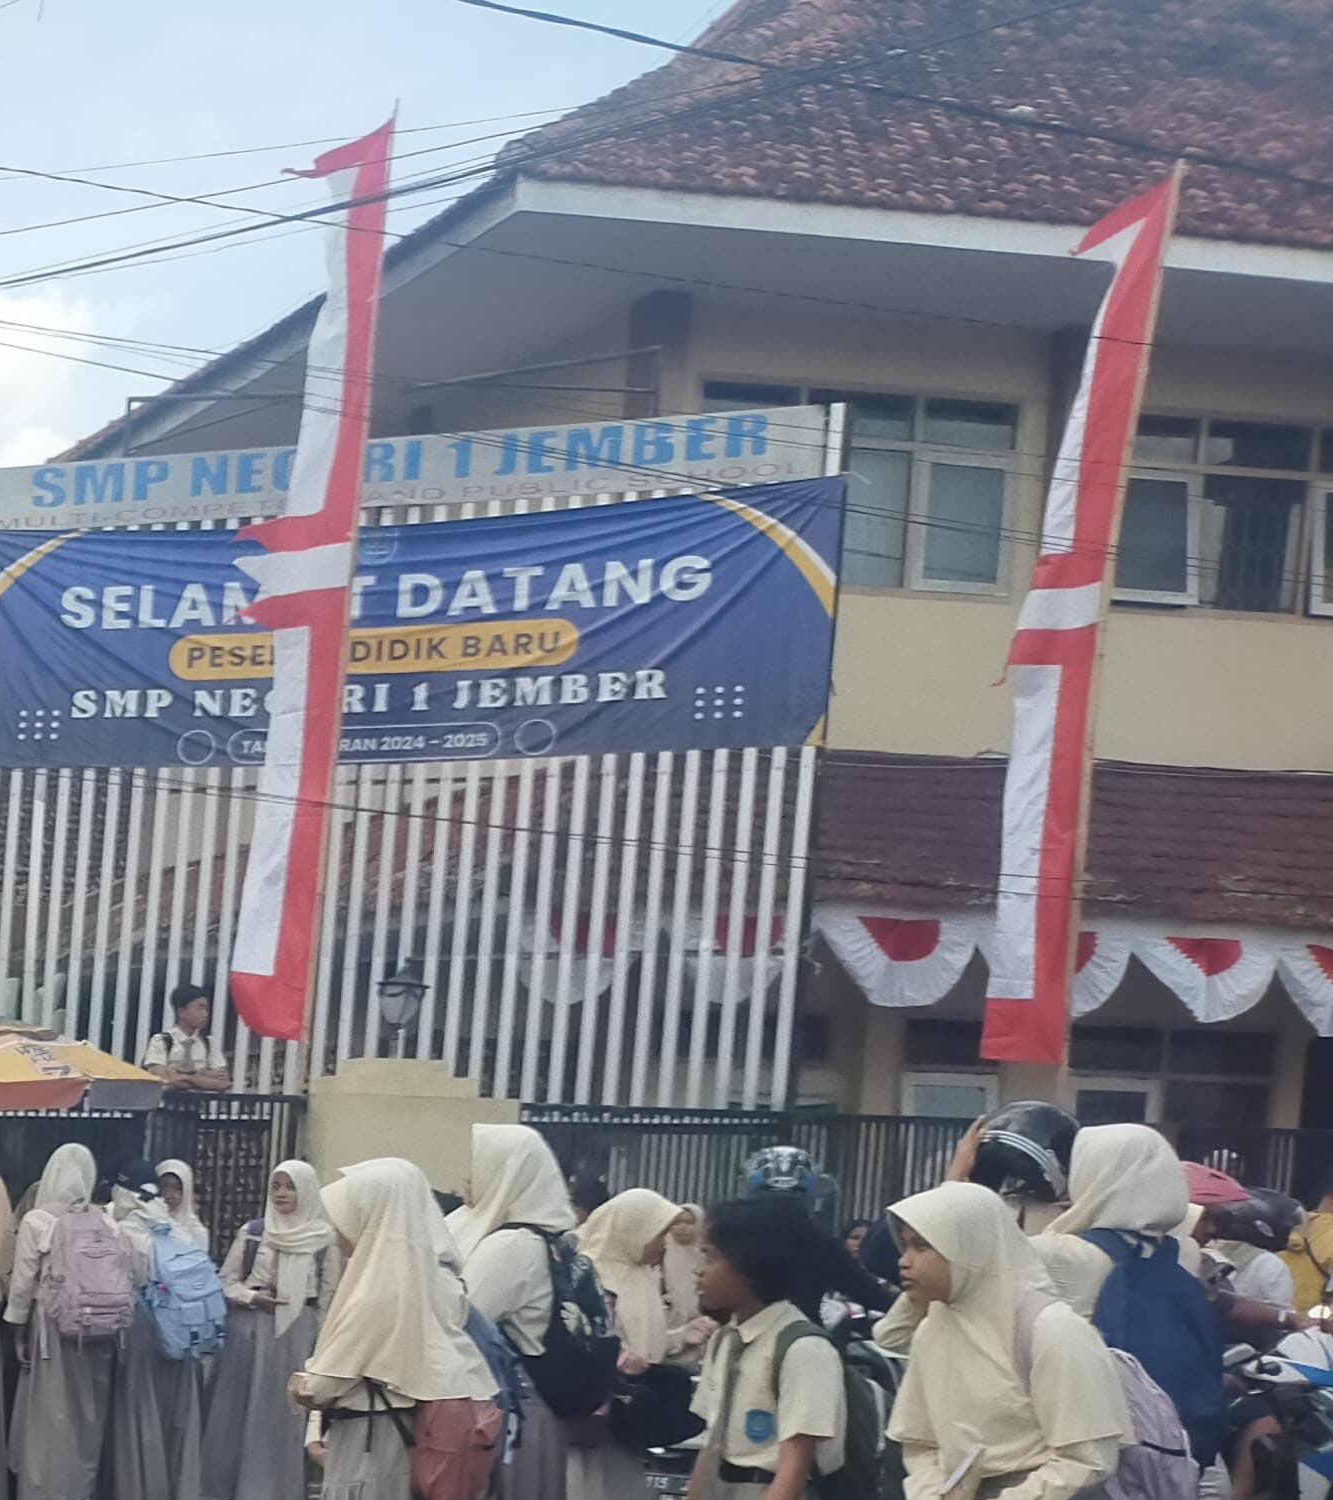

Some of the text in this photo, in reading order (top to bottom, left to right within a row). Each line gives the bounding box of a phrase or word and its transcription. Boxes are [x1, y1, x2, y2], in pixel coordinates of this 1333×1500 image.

[31, 459, 170, 509] SMP
[447, 437, 472, 479] 1
[492, 413, 769, 477] JEMBER
[60, 555, 713, 630] SELAMT DATANG
[461, 631, 561, 658] BARU
[70, 669, 668, 720] SMP NERI 1 JEMBER
[380, 735, 425, 751] 2024
[441, 732, 490, 749] 2025
